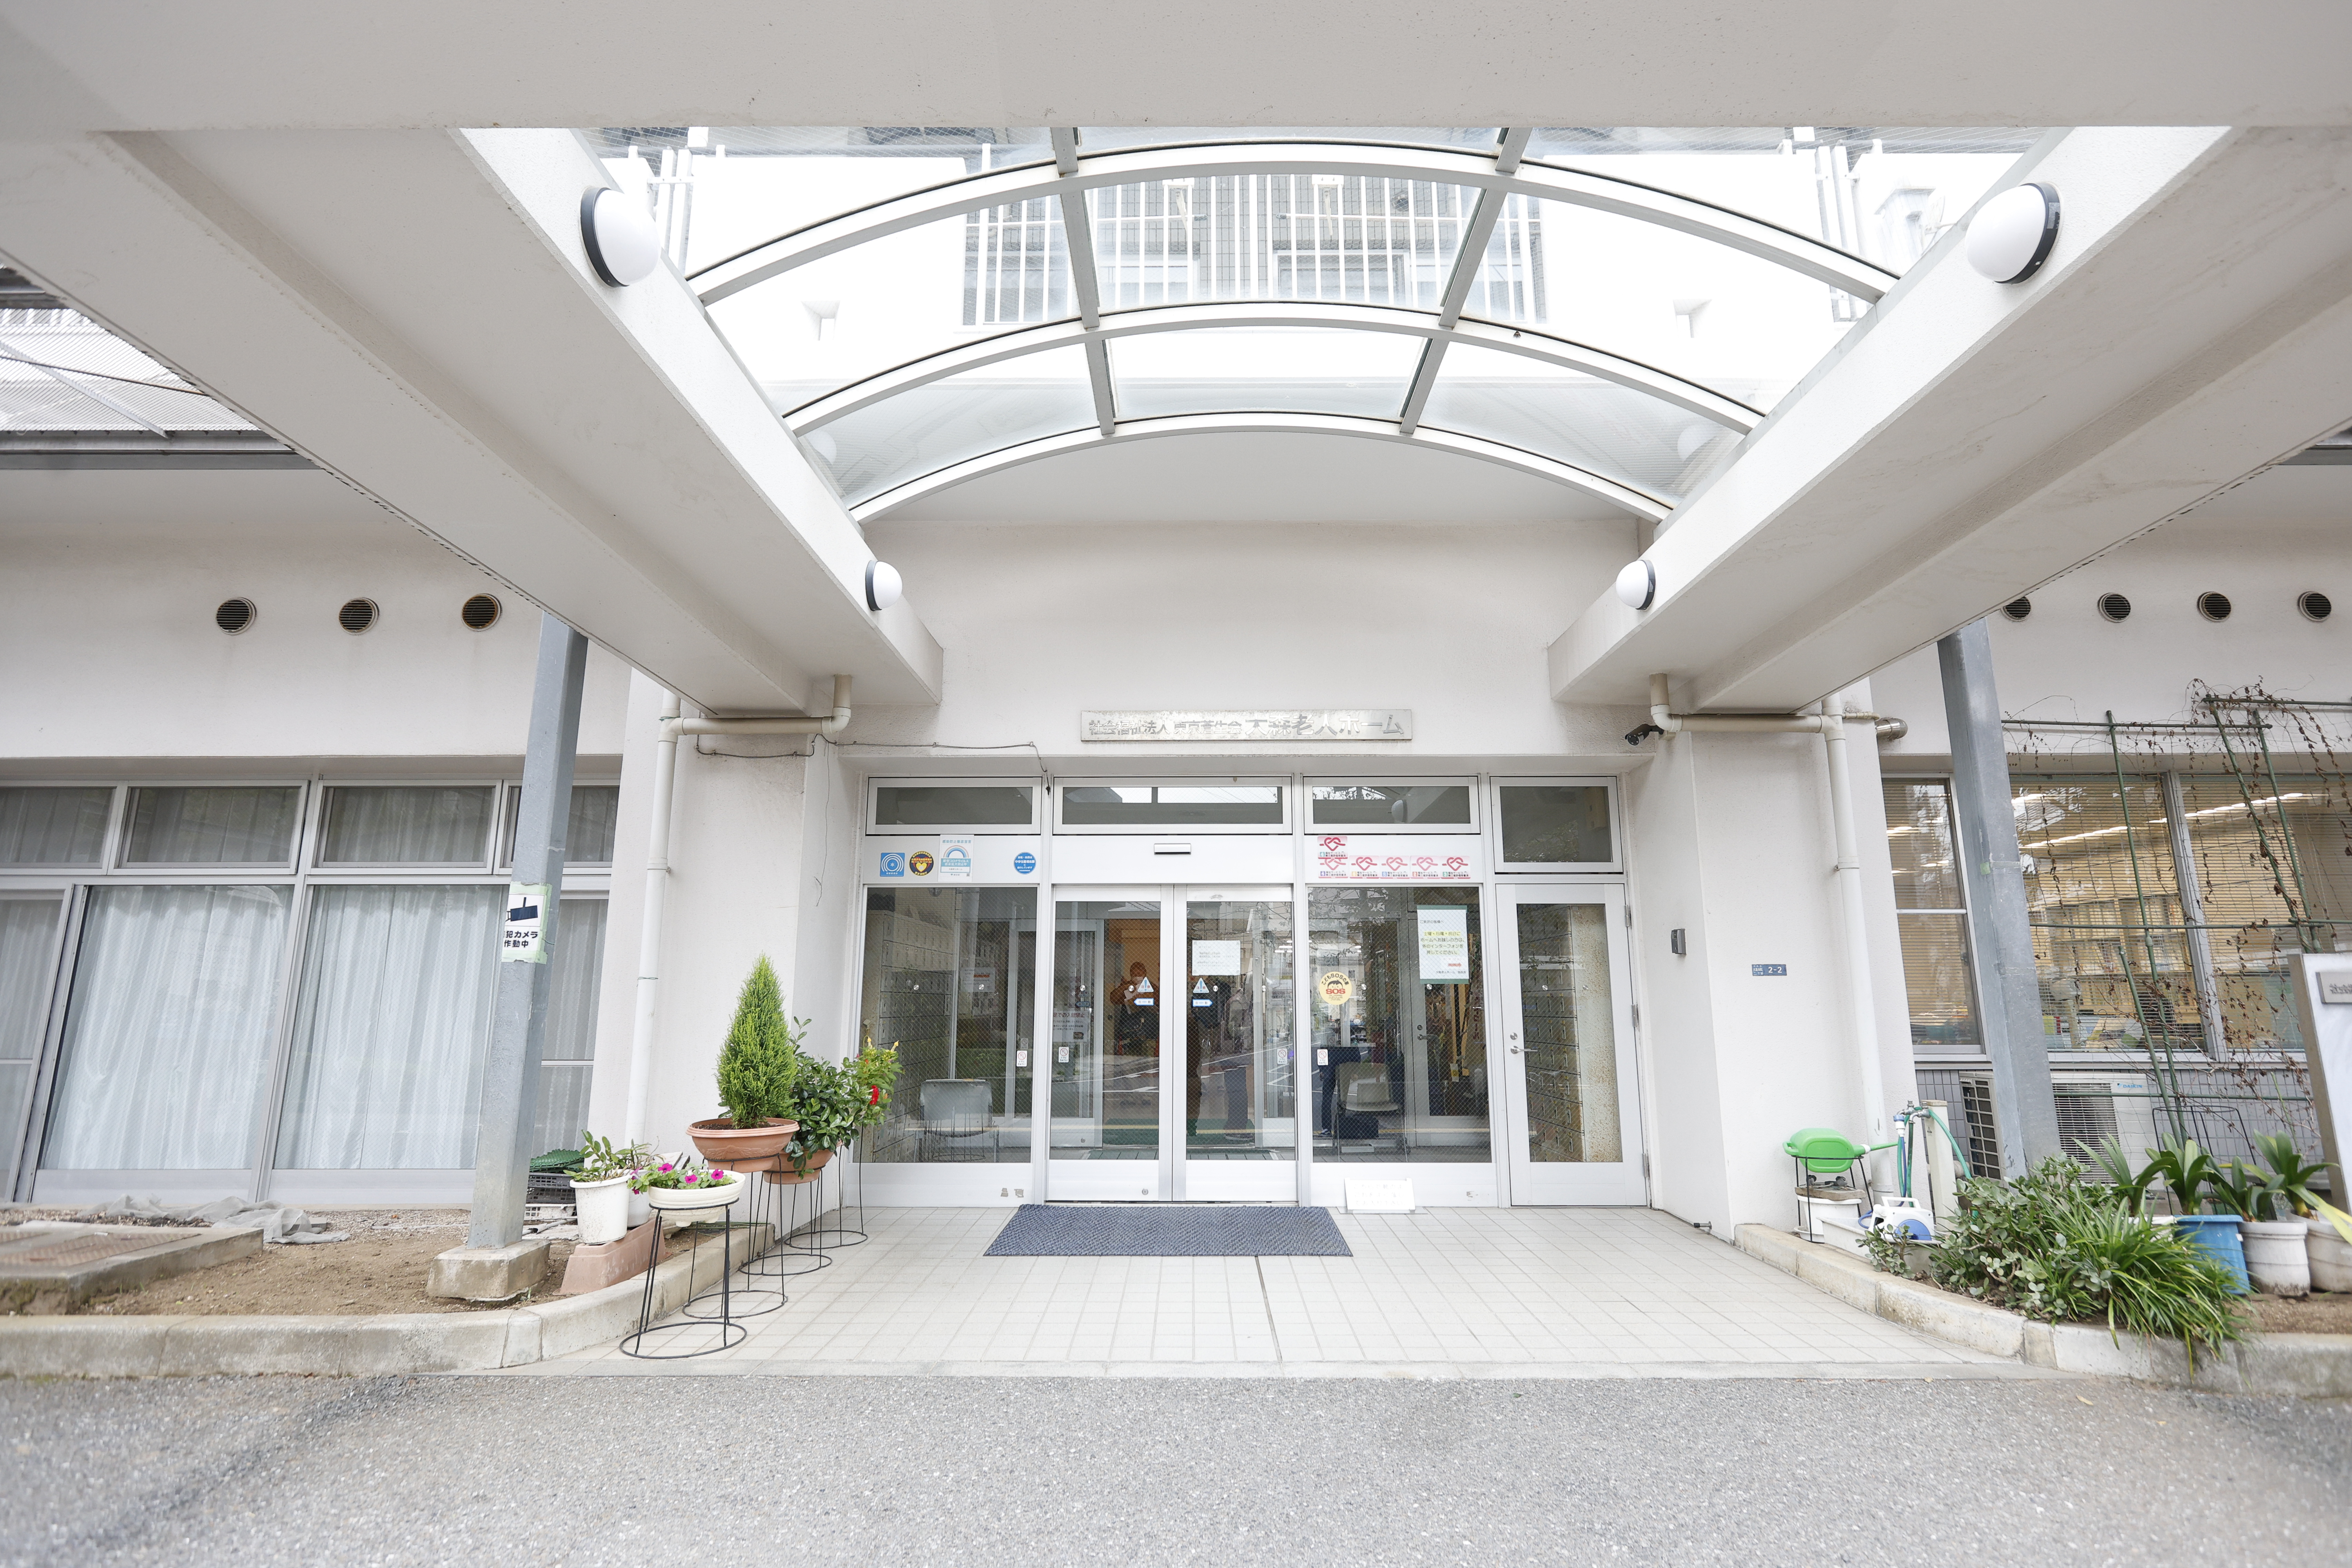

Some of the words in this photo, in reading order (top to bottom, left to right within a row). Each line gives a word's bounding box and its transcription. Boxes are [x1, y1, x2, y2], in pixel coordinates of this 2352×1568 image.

[1089, 720, 1170, 735] 社会福祉法人
[1174, 720, 1242, 735] 東京蒼生会
[1245, 713, 1404, 736] 大森老人ホーム
[504, 931, 538, 939] 犯カメラ
[504, 940, 529, 948] 作動中
